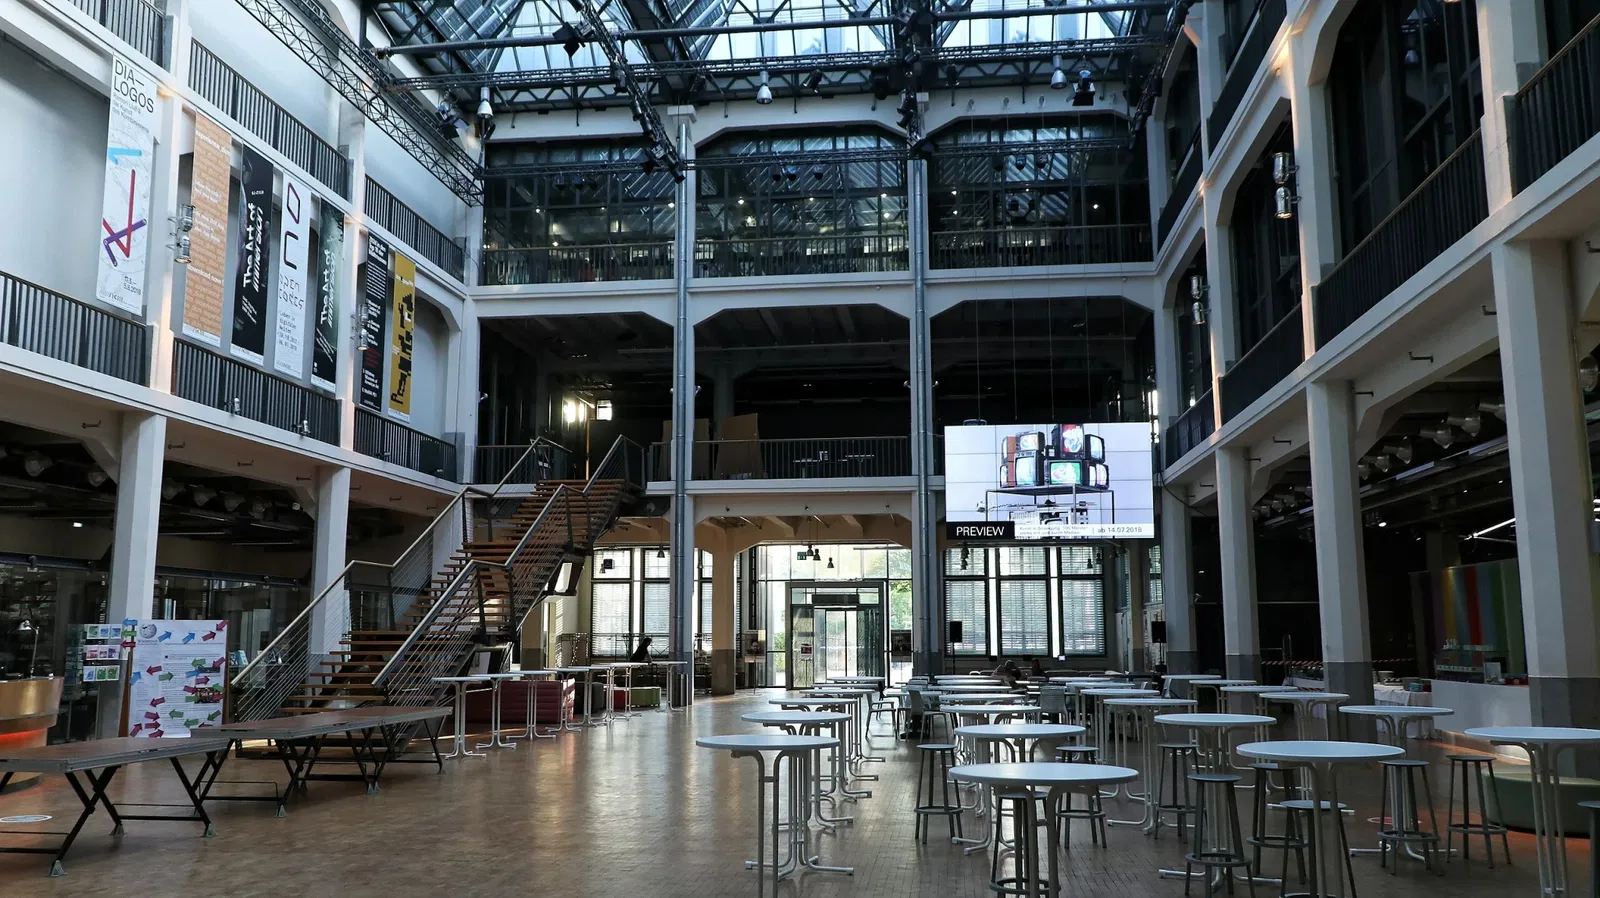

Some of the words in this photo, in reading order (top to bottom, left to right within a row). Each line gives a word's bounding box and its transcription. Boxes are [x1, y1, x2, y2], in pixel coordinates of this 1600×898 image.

[114, 76, 154, 113] LOGOS
[248, 202, 256, 220] of
[245, 224, 254, 251] Art
[324, 248, 332, 266] of
[242, 254, 253, 288] The
[322, 268, 330, 292] Art
[320, 294, 330, 324] The
[956, 526, 1005, 537] PREVIEW
